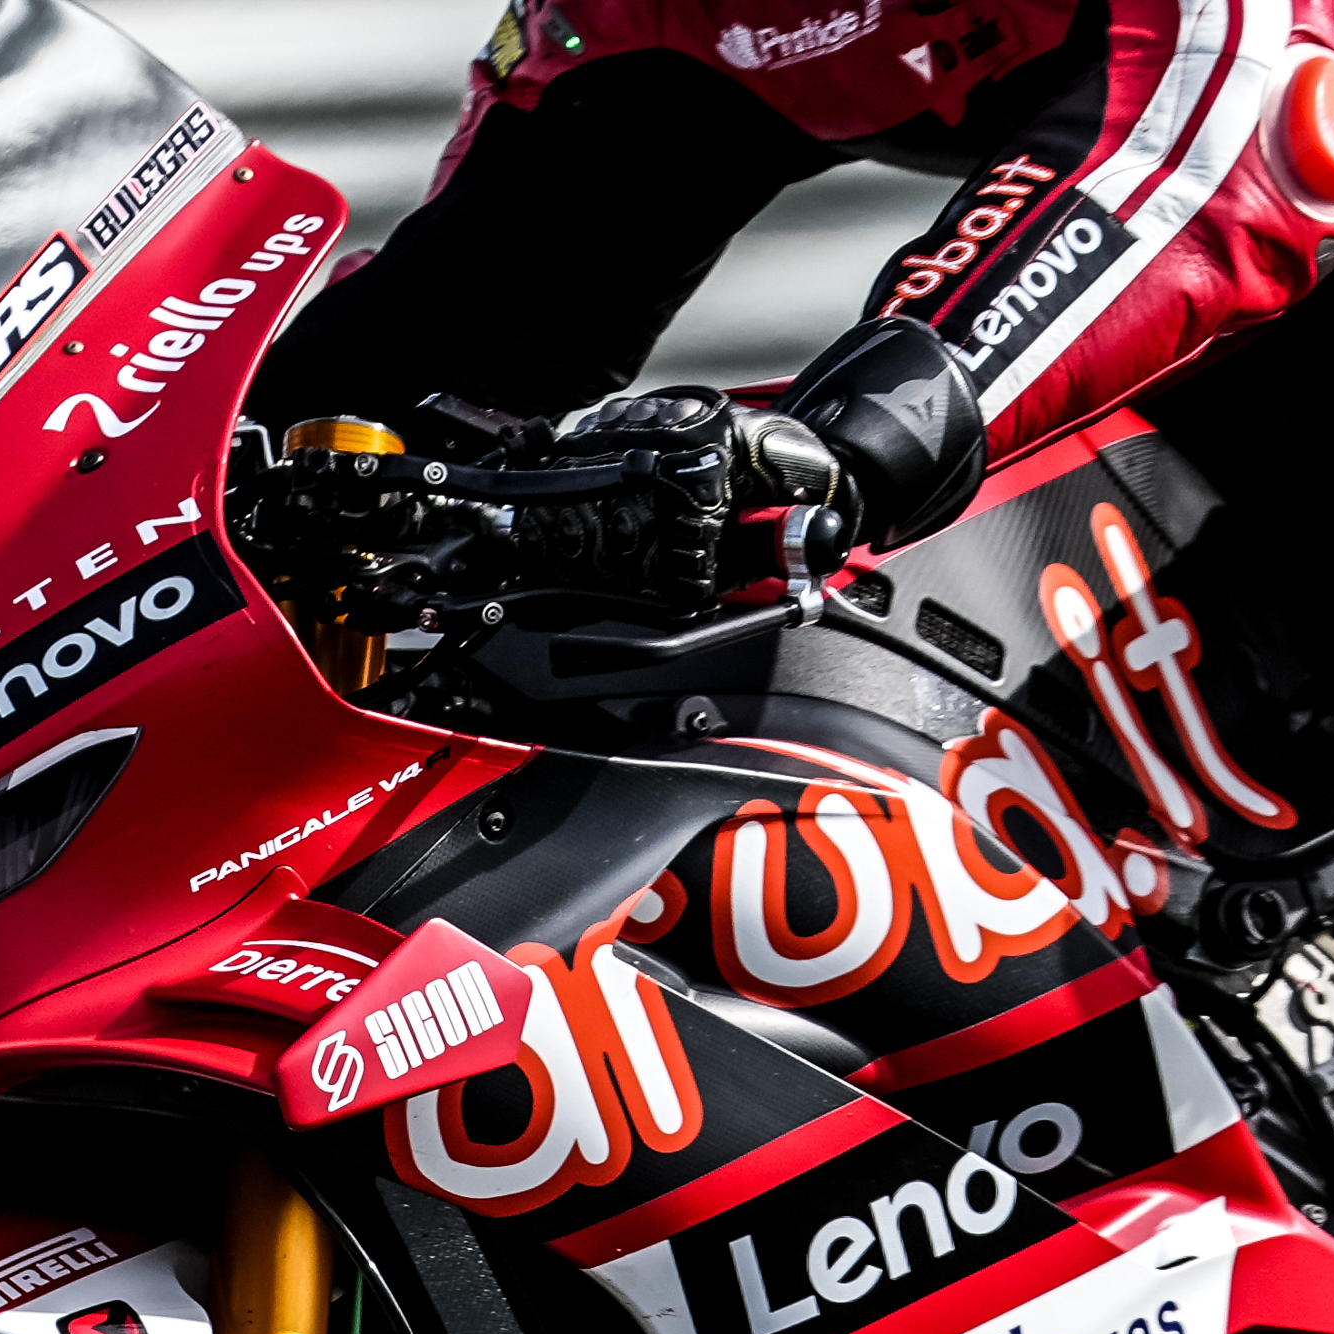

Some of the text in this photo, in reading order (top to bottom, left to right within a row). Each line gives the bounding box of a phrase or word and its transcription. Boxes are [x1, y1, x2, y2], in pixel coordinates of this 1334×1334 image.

[109, 213, 325, 393] riello ups
[943, 217, 1103, 372] Lenovo
[189, 787, 374, 892] PANIGALE
[379, 762, 423, 792] V4
[384, 502, 1297, 1216] aruba.it
[364, 960, 505, 1080] SICOM
